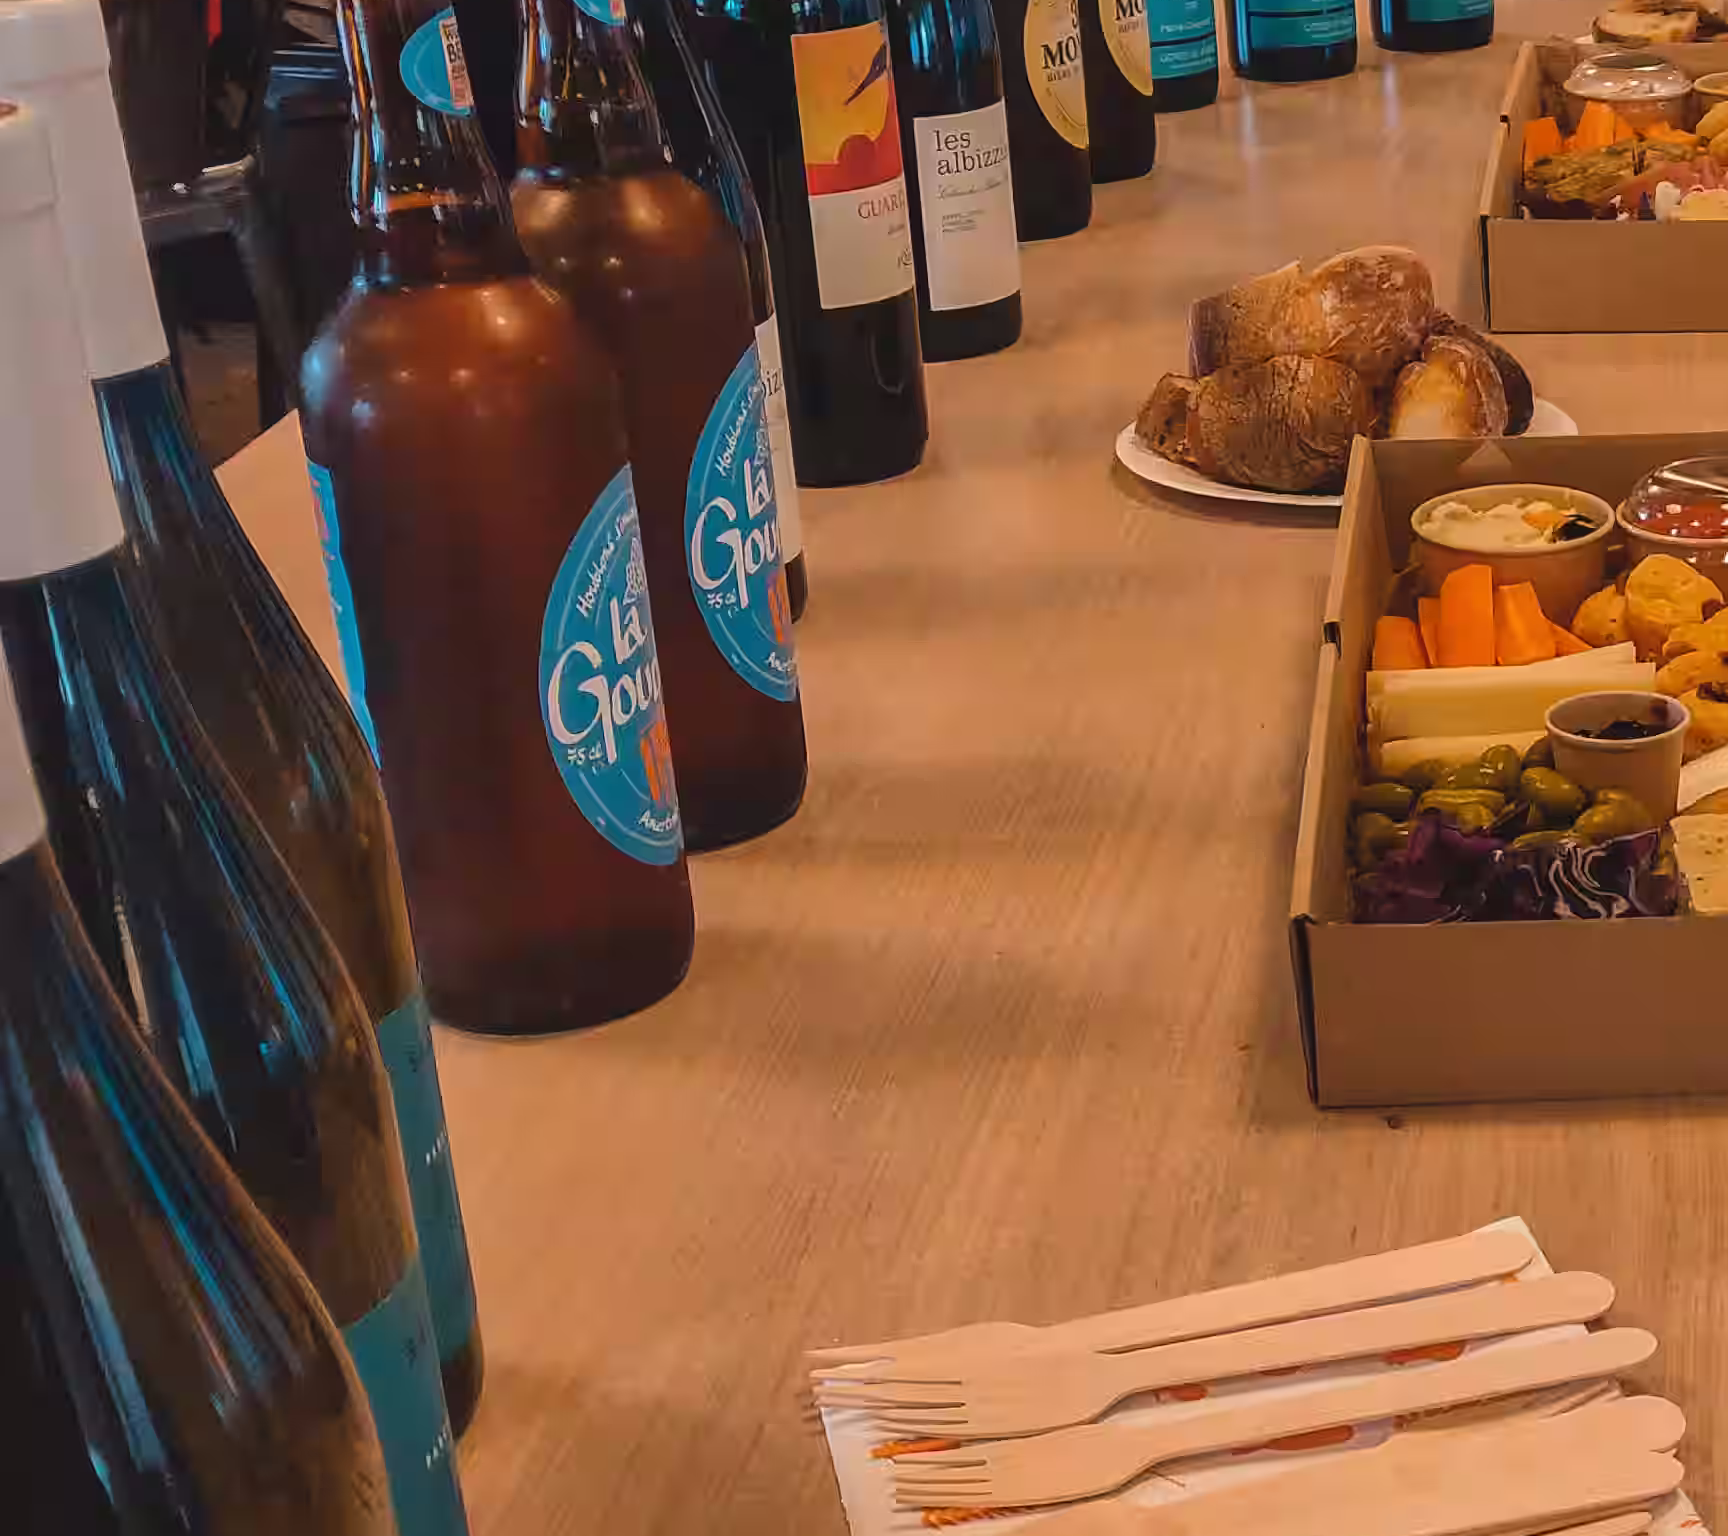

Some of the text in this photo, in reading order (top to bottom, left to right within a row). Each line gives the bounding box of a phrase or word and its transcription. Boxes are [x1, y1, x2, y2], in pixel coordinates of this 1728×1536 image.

[1040, 33, 1081, 70] MO
[932, 128, 971, 152] les
[691, 496, 780, 609] Gou
[610, 596, 649, 664] la
